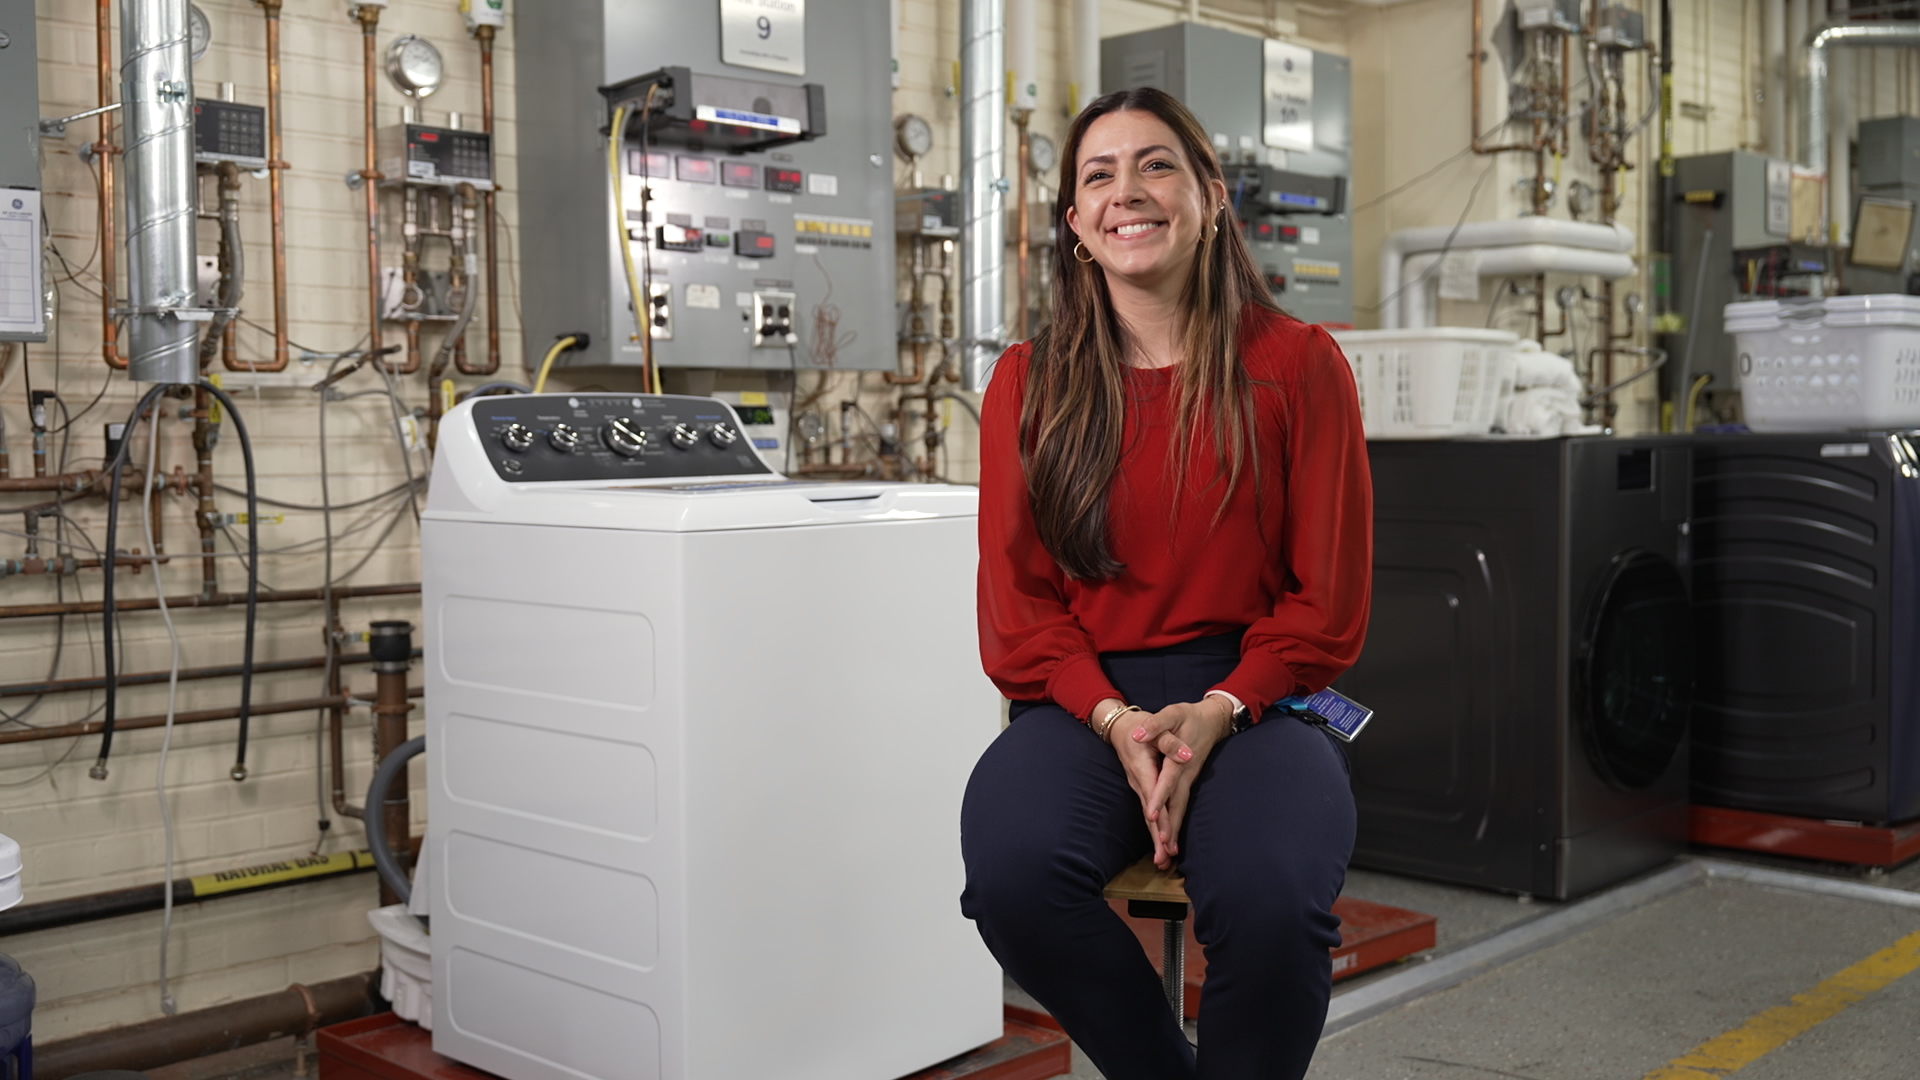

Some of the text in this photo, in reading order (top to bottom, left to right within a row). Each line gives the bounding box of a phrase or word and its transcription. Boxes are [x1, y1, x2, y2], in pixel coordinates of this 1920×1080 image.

[757, 16, 771, 40] 9
[214, 855, 329, 882] NATURAL GAS
